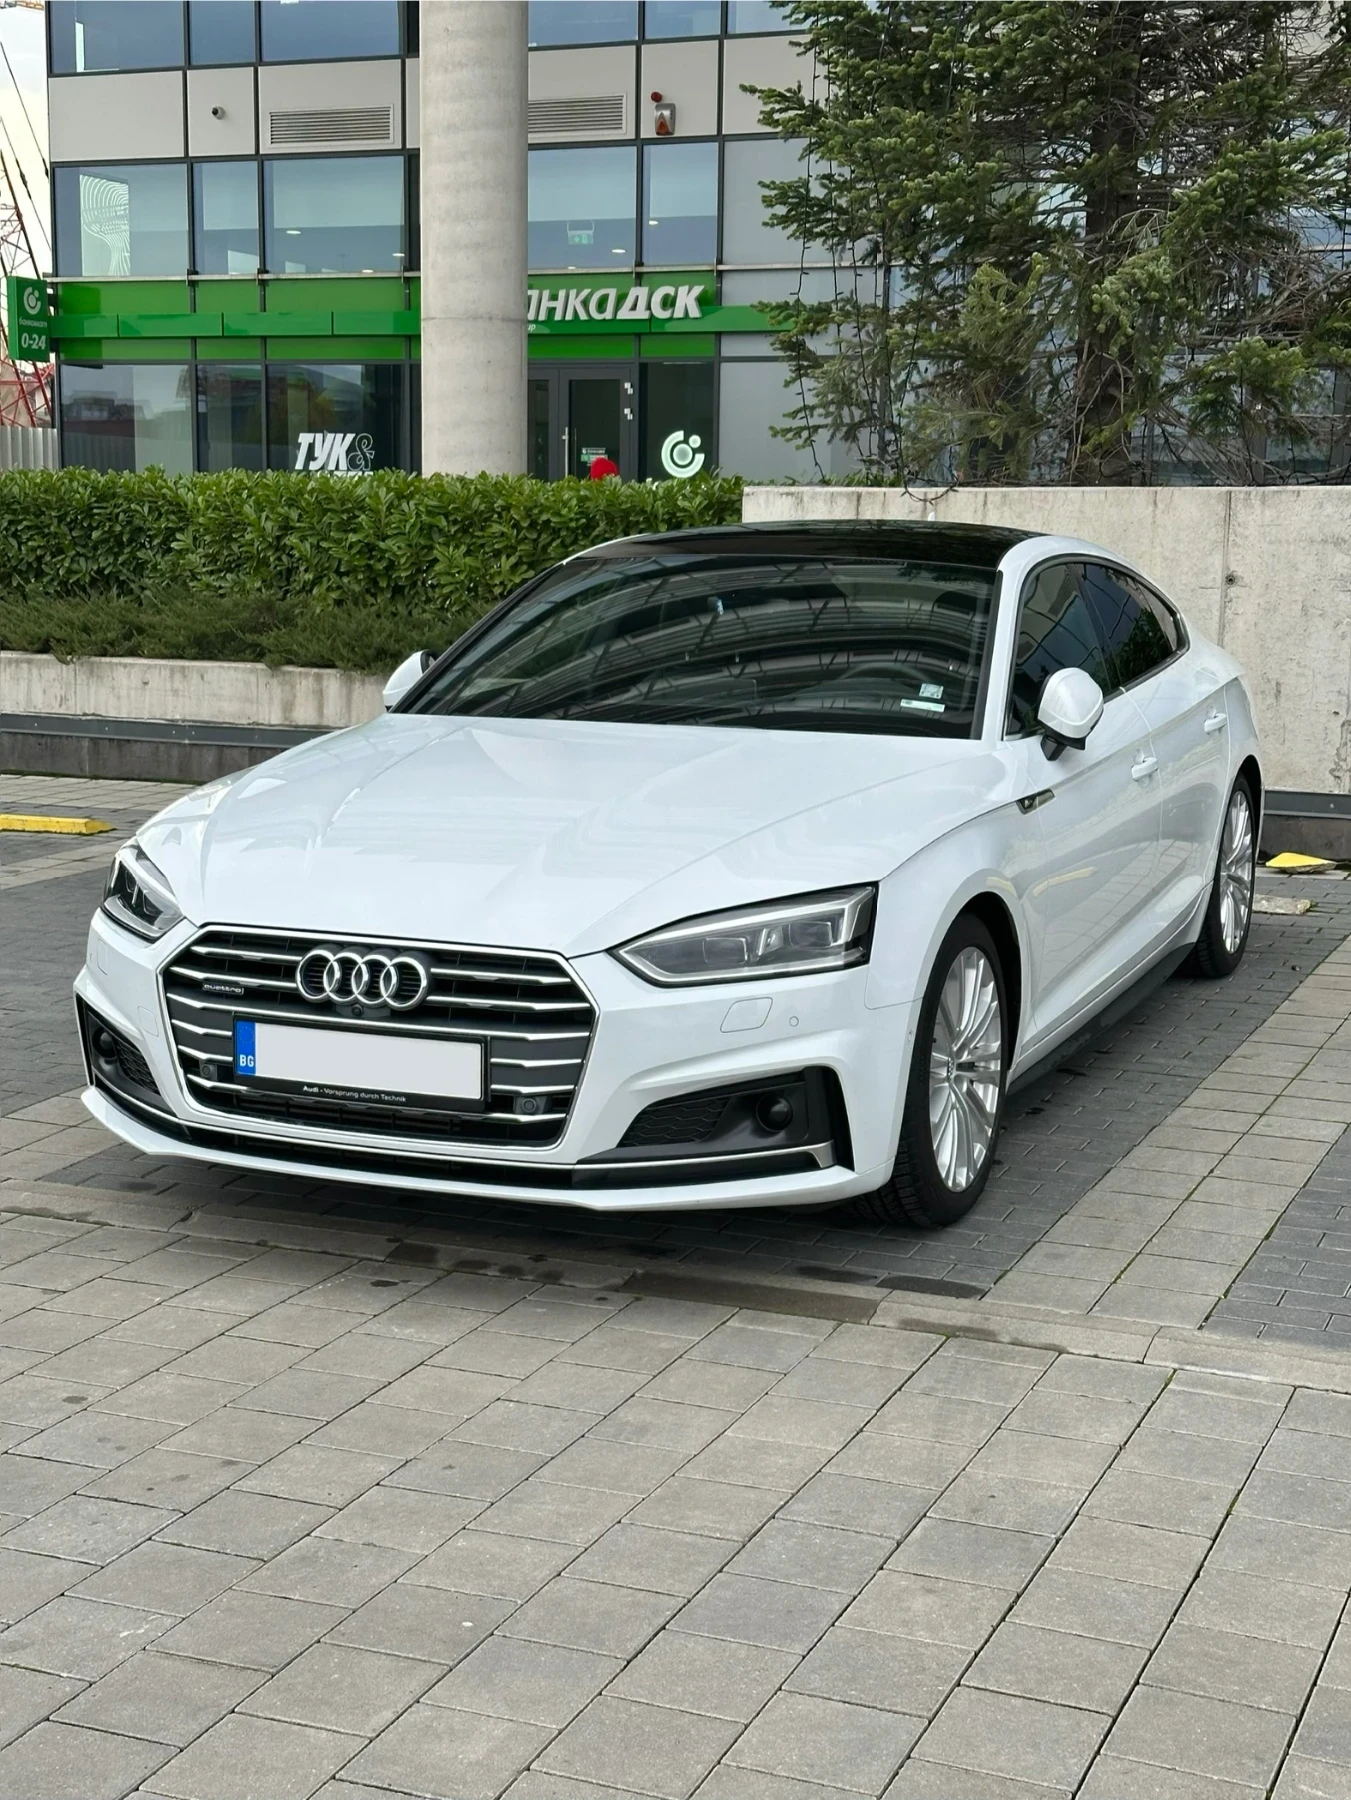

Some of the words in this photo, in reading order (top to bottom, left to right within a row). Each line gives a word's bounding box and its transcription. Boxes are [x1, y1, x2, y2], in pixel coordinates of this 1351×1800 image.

[21, 333, 46, 350] 0-24
[202, 984, 242, 993] quattro
[239, 1054, 255, 1068] BG
[303, 1085, 319, 1093] Audi
[324, 1088, 359, 1098] Vorsprung
[360, 1092, 380, 1100] durch
[381, 1094, 407, 1102] Technik
